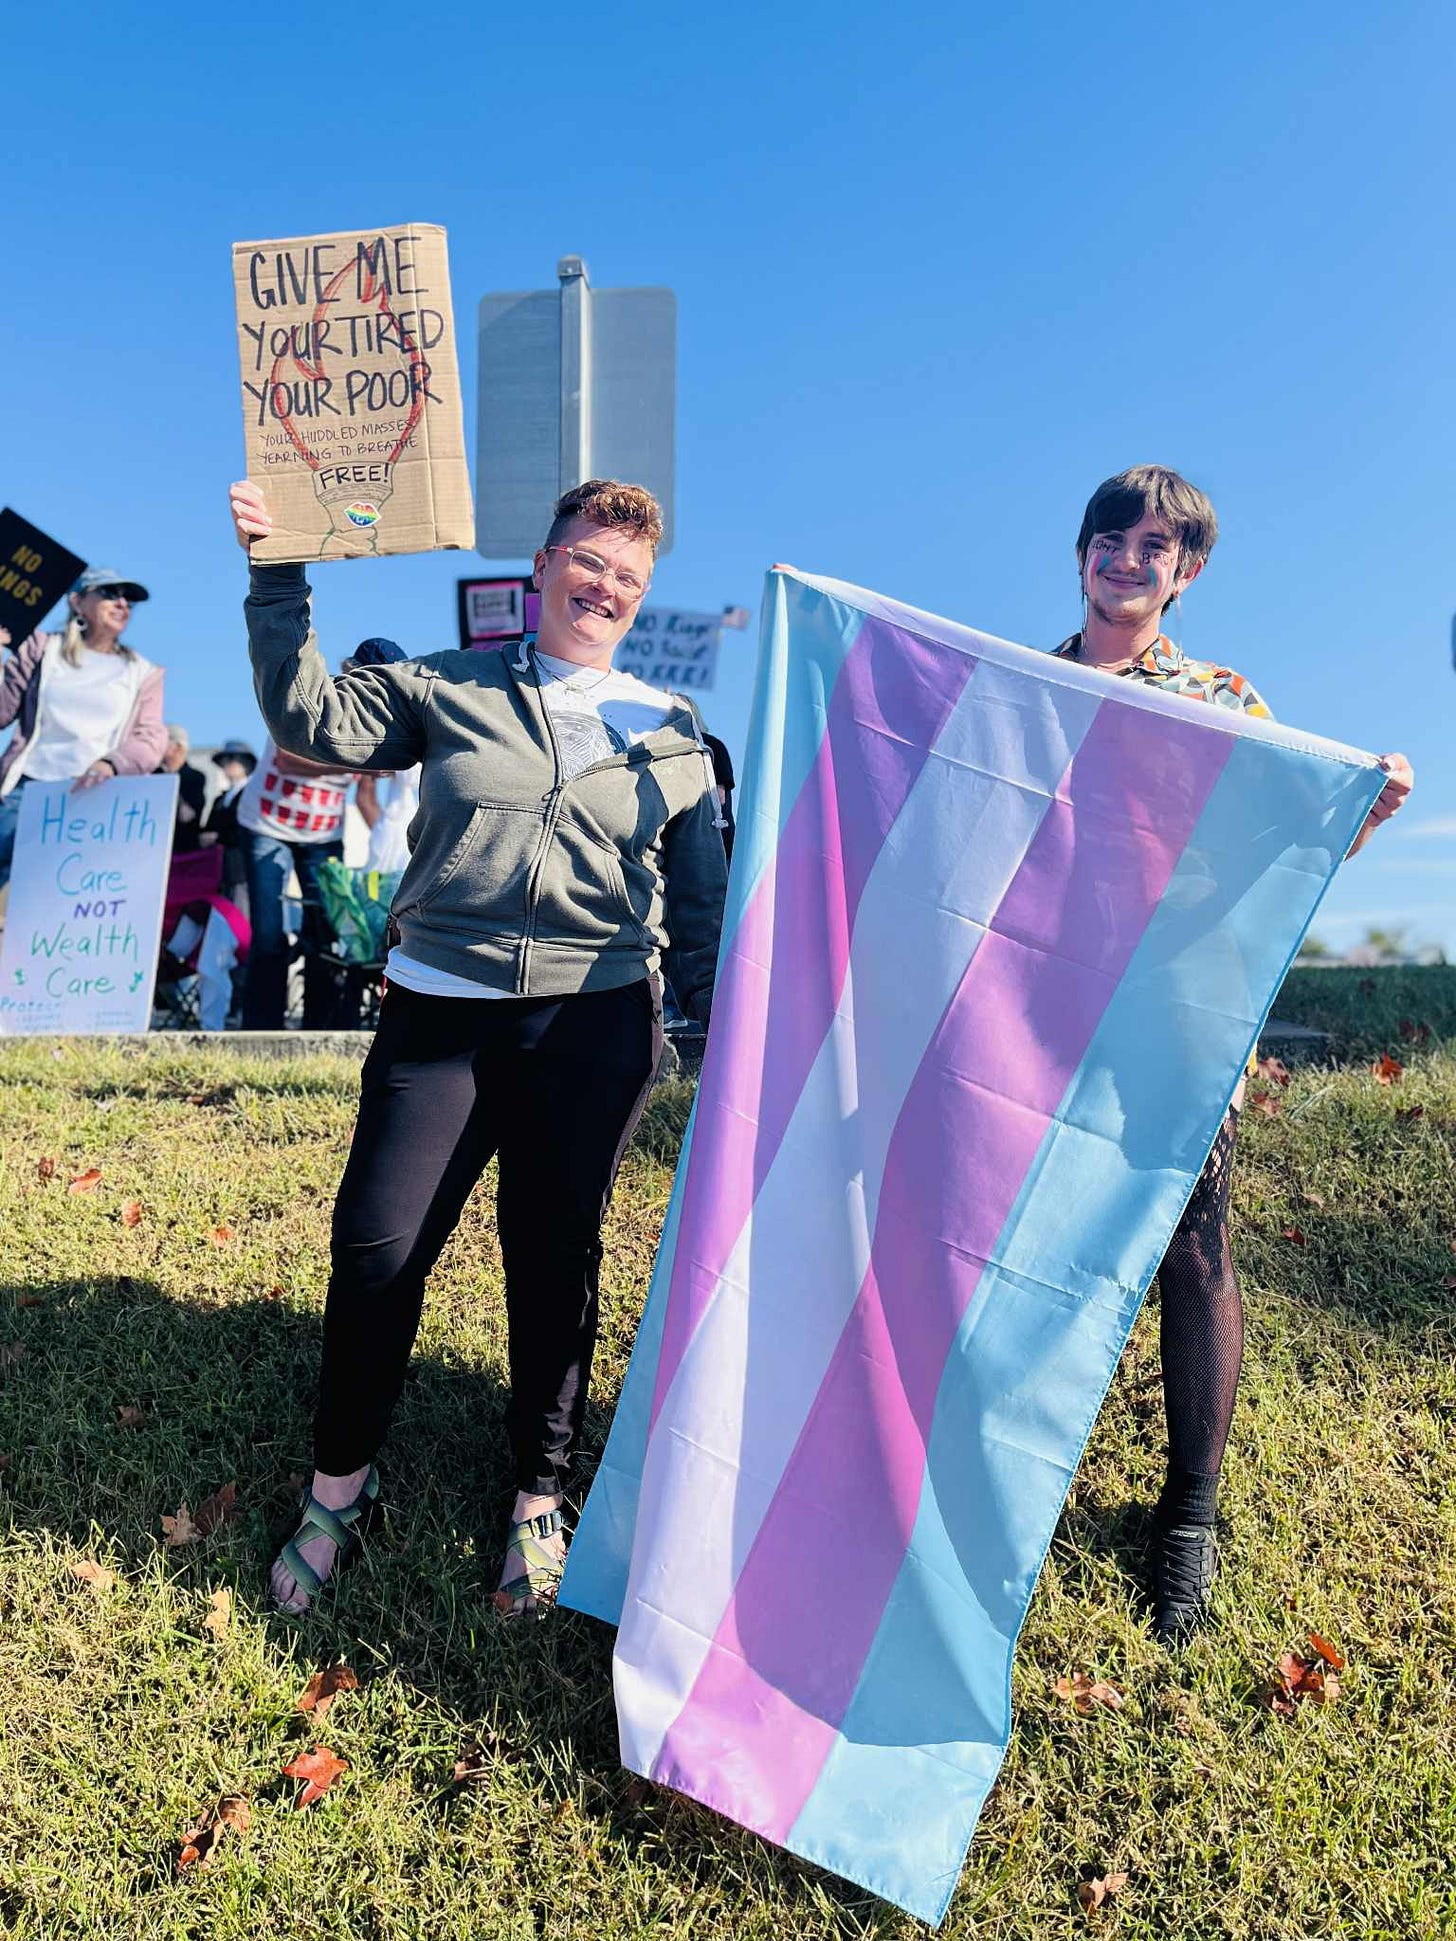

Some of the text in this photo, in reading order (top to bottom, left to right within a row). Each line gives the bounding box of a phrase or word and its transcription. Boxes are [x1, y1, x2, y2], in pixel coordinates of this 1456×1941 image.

[250, 237, 428, 309] GIVE ME
[242, 309, 444, 371] YOUR TIRED
[243, 362, 443, 426] YOUR POOR
[256, 435, 418, 465] YEARNING TO BREATHE
[258, 419, 415, 447] YOUR HUDDLED MASSES
[319, 463, 389, 490] FREE!
[10, 544, 43, 573] NO
[0, 565, 43, 607] INGS
[623, 639, 653, 657] NO
[41, 794, 156, 846] Health
[56, 852, 127, 896] Care
[73, 900, 127, 919] NOT
[31, 922, 139, 963] Wealth
[46, 967, 116, 998] Care
